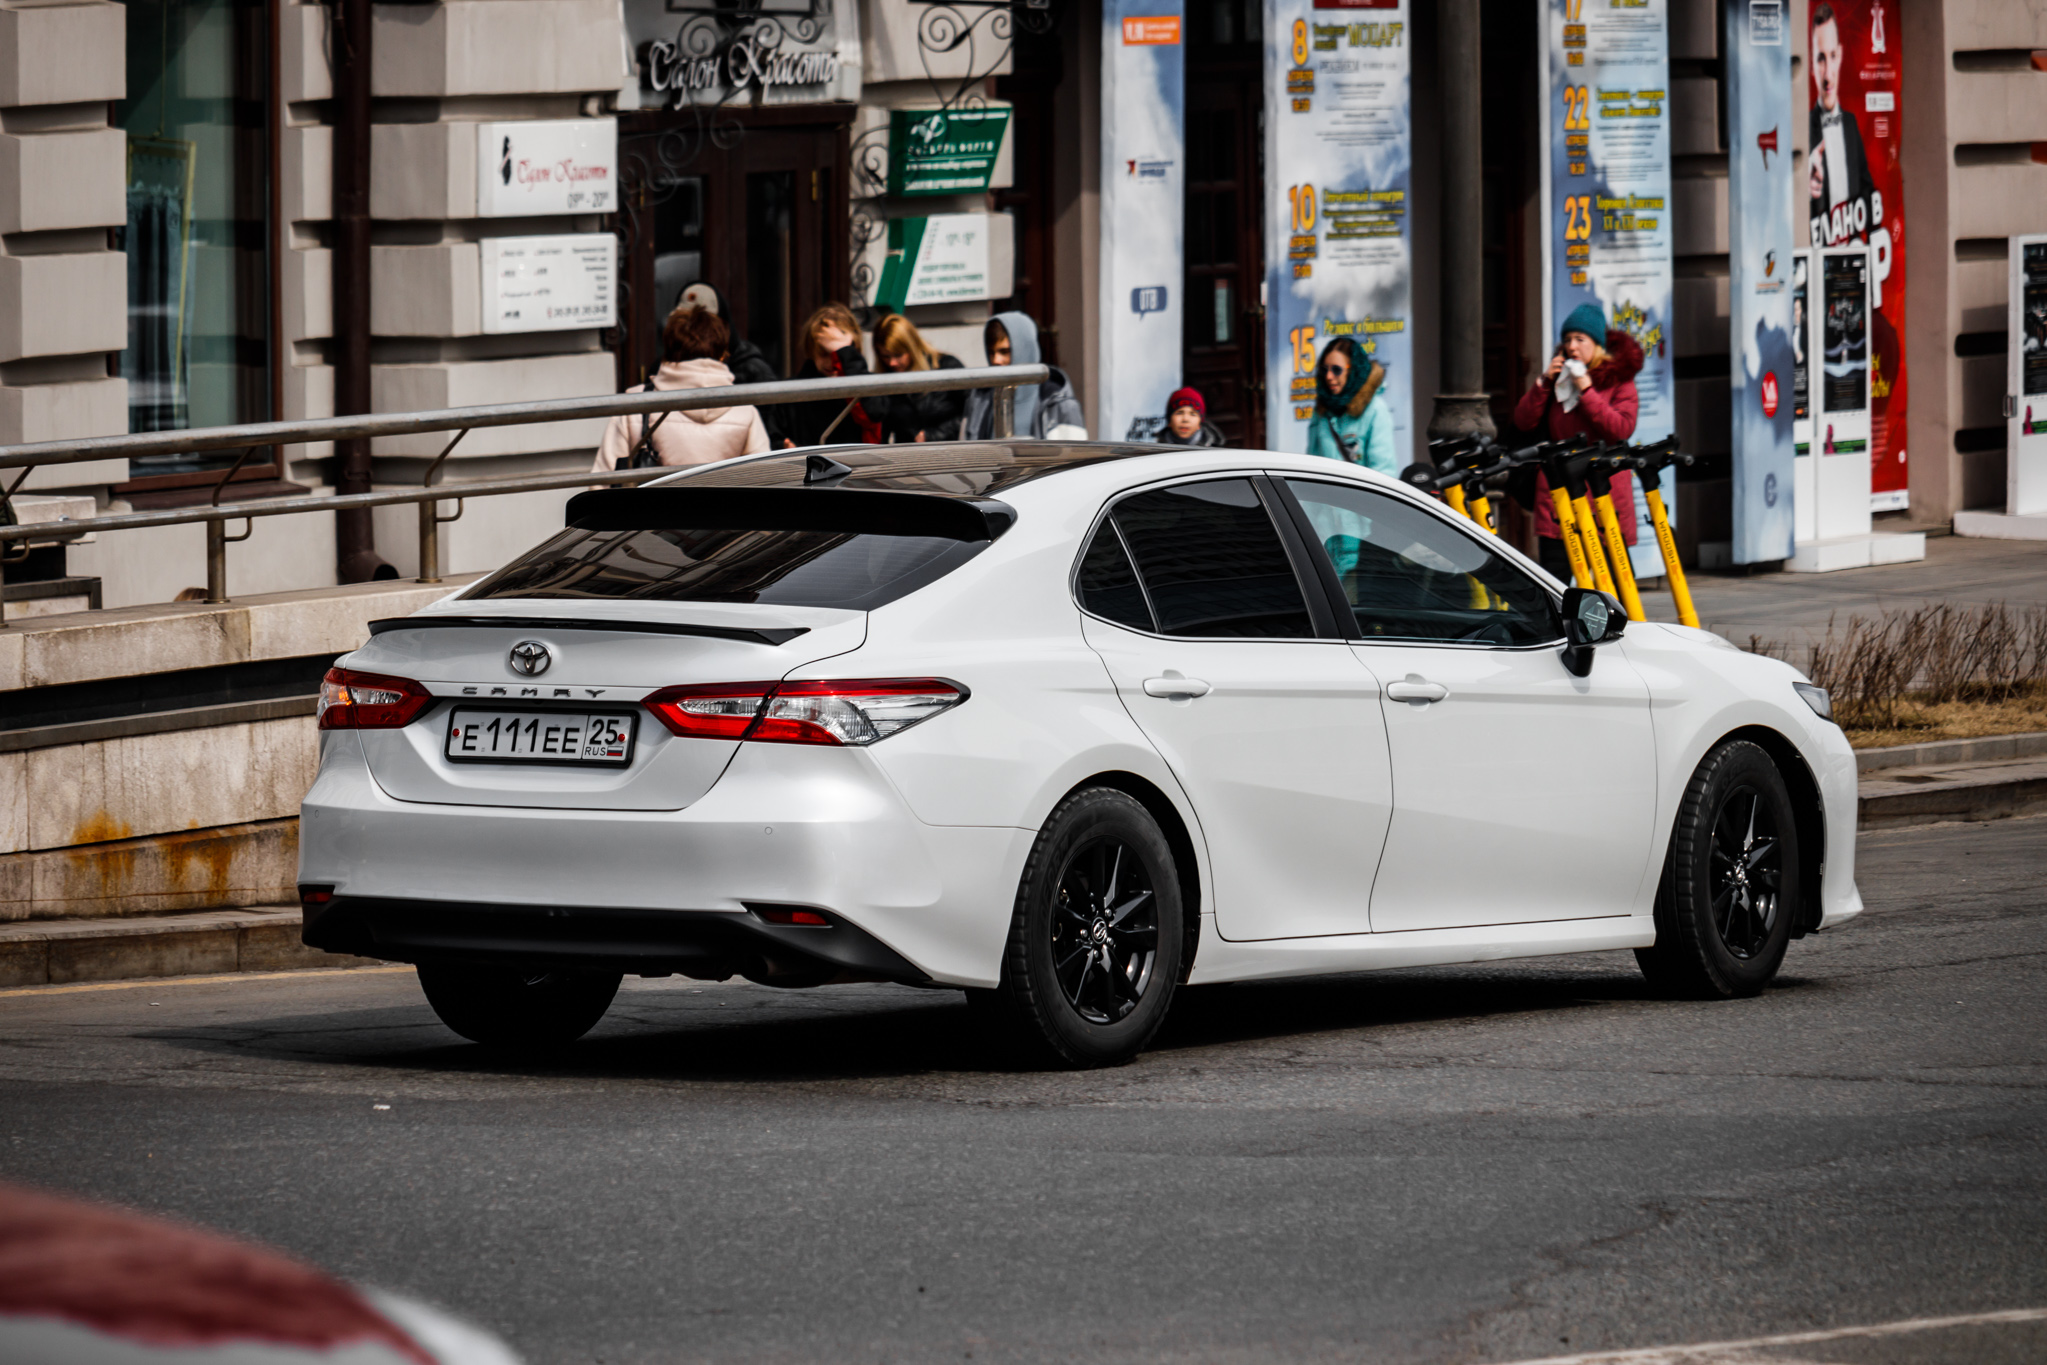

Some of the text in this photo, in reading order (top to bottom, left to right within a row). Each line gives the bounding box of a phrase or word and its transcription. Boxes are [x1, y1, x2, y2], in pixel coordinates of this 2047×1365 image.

[1292, 18, 1308, 66] 8
[1347, 23, 1403, 48] МОЦАРТ
[650, 36, 838, 110] Салон Красоты
[1564, 85, 1590, 130] 22
[1288, 184, 1316, 231] 10
[1564, 195, 1592, 240] 23
[1871, 190, 1883, 225] В
[1290, 326, 1316, 373] 15
[1564, 519, 1581, 562] WHOOSH
[1586, 529, 1605, 574] WHOOSH
[1609, 526, 1628, 571] WHOOSH
[1659, 521, 1676, 565] WHOOSH
[462, 686, 606, 698] CAMRY
[462, 717, 620, 754] E111EE 25
[585, 746, 606, 756] RUS
